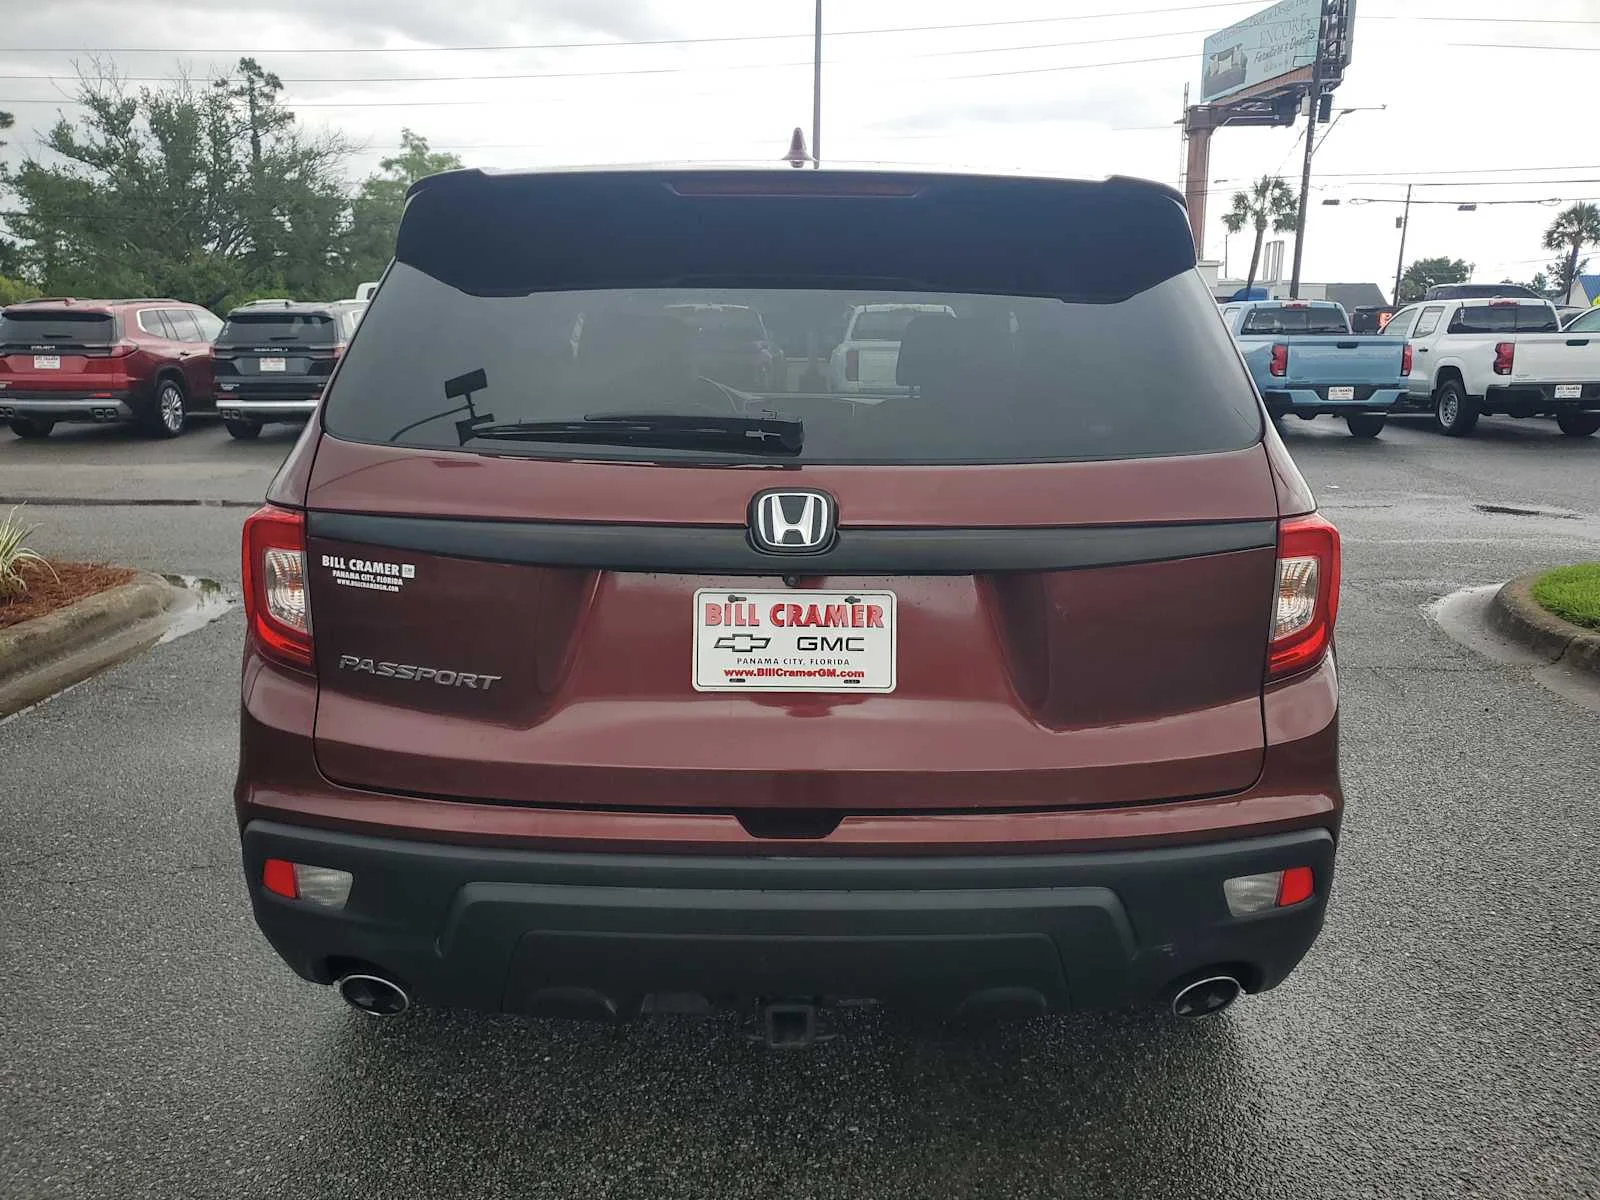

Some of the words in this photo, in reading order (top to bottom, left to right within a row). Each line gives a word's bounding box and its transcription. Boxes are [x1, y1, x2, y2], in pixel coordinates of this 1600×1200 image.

[321, 555, 346, 569] BILL
[349, 558, 400, 576] CRAMER
[332, 570, 360, 580] PANAMA
[376, 576, 404, 586] FLORIDA
[705, 603, 760, 627] BILL
[769, 603, 884, 628] CRAMER
[796, 636, 865, 652] GMC
[736, 657, 779, 665] PANAMA
[783, 658, 806, 666] CITY,
[810, 658, 850, 666] FLORIDA
[338, 654, 502, 691] PASSPORT
[724, 667, 865, 679] www.BillCramerGM.com
